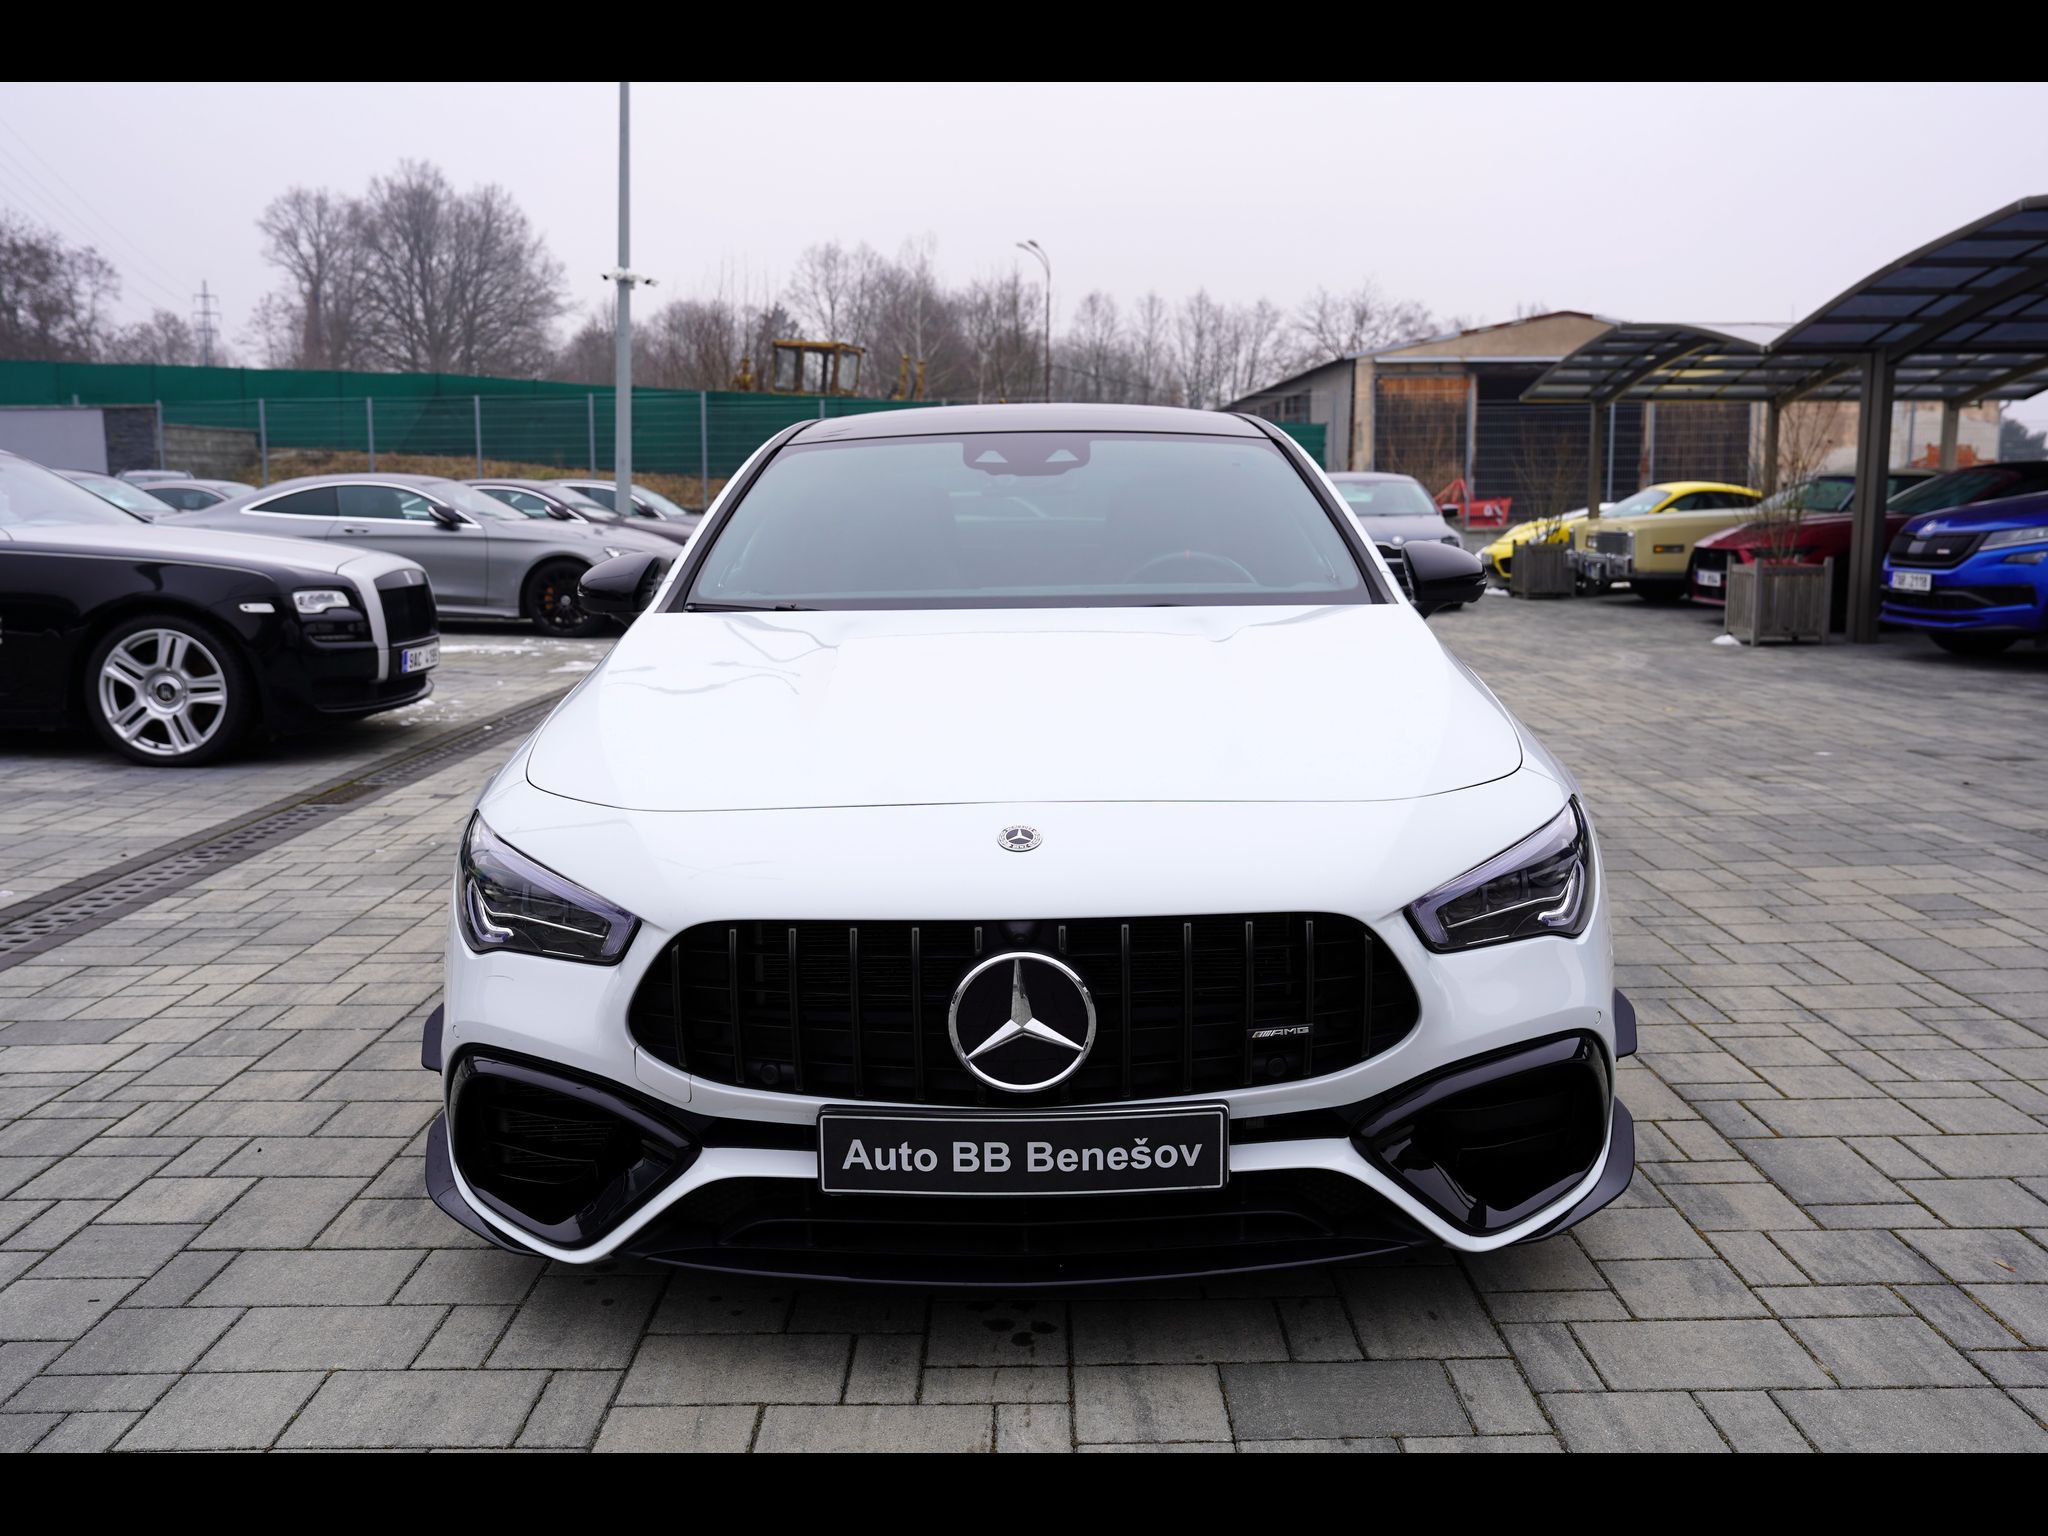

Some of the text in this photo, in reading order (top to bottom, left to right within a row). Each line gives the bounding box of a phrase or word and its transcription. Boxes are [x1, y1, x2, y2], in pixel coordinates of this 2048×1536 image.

[1270, 1026, 1310, 1037] AMG
[842, 1137, 1203, 1173] Auto BB Benešov
